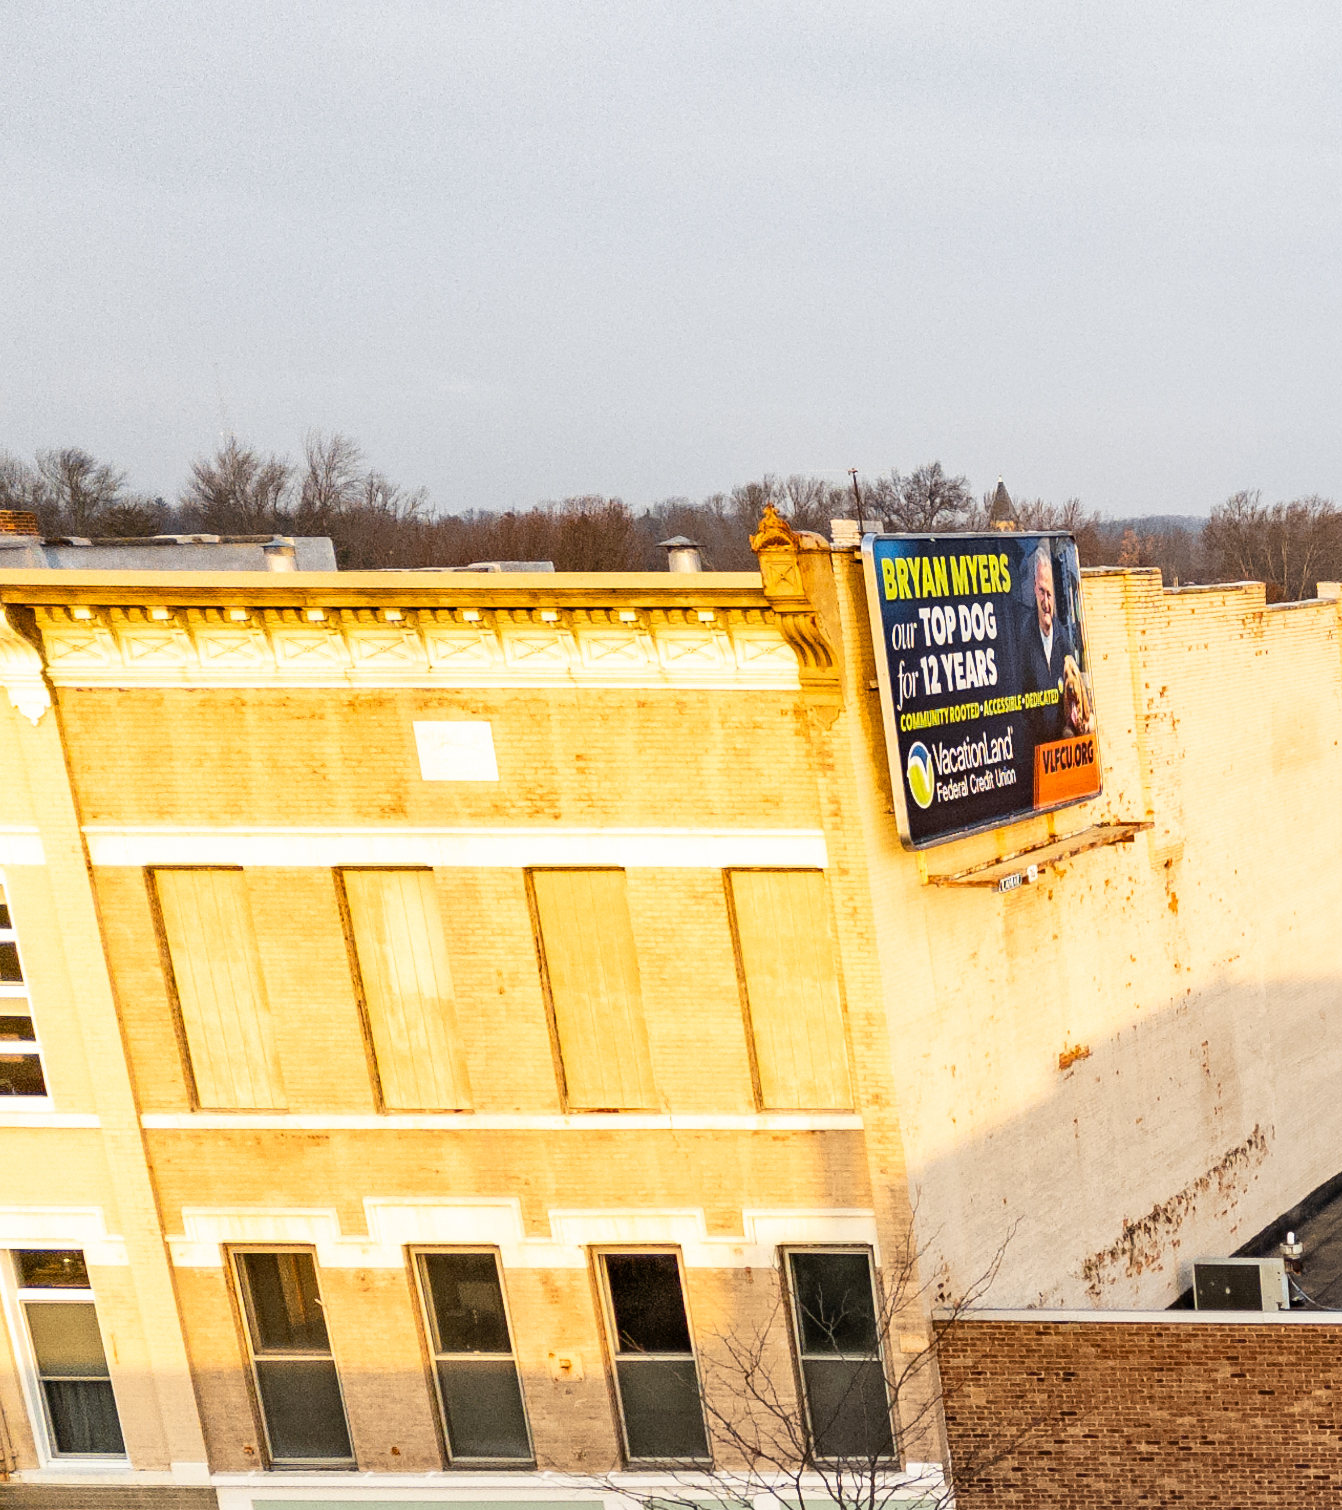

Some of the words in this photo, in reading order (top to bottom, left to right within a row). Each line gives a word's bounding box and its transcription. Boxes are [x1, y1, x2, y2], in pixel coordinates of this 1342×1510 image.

[881, 556, 950, 600] BRYAN
[950, 553, 1012, 596] MYERS
[892, 622, 918, 650] our
[918, 605, 957, 647] TOP
[958, 601, 998, 643] DOG
[897, 660, 919, 711] for
[920, 654, 942, 696] 12
[940, 647, 998, 692] YEARS
[900, 706, 950, 732] COMMUNITY
[950, 702, 980, 723] ROOTED
[1025, 688, 1059, 709] DEDICATED
[932, 728, 1013, 776] VacationLand
[1043, 740, 1094, 774] VLFCU.ORG
[936, 775, 969, 802] Federal
[969, 770, 995, 794] Credit
[995, 766, 1017, 788] Union
